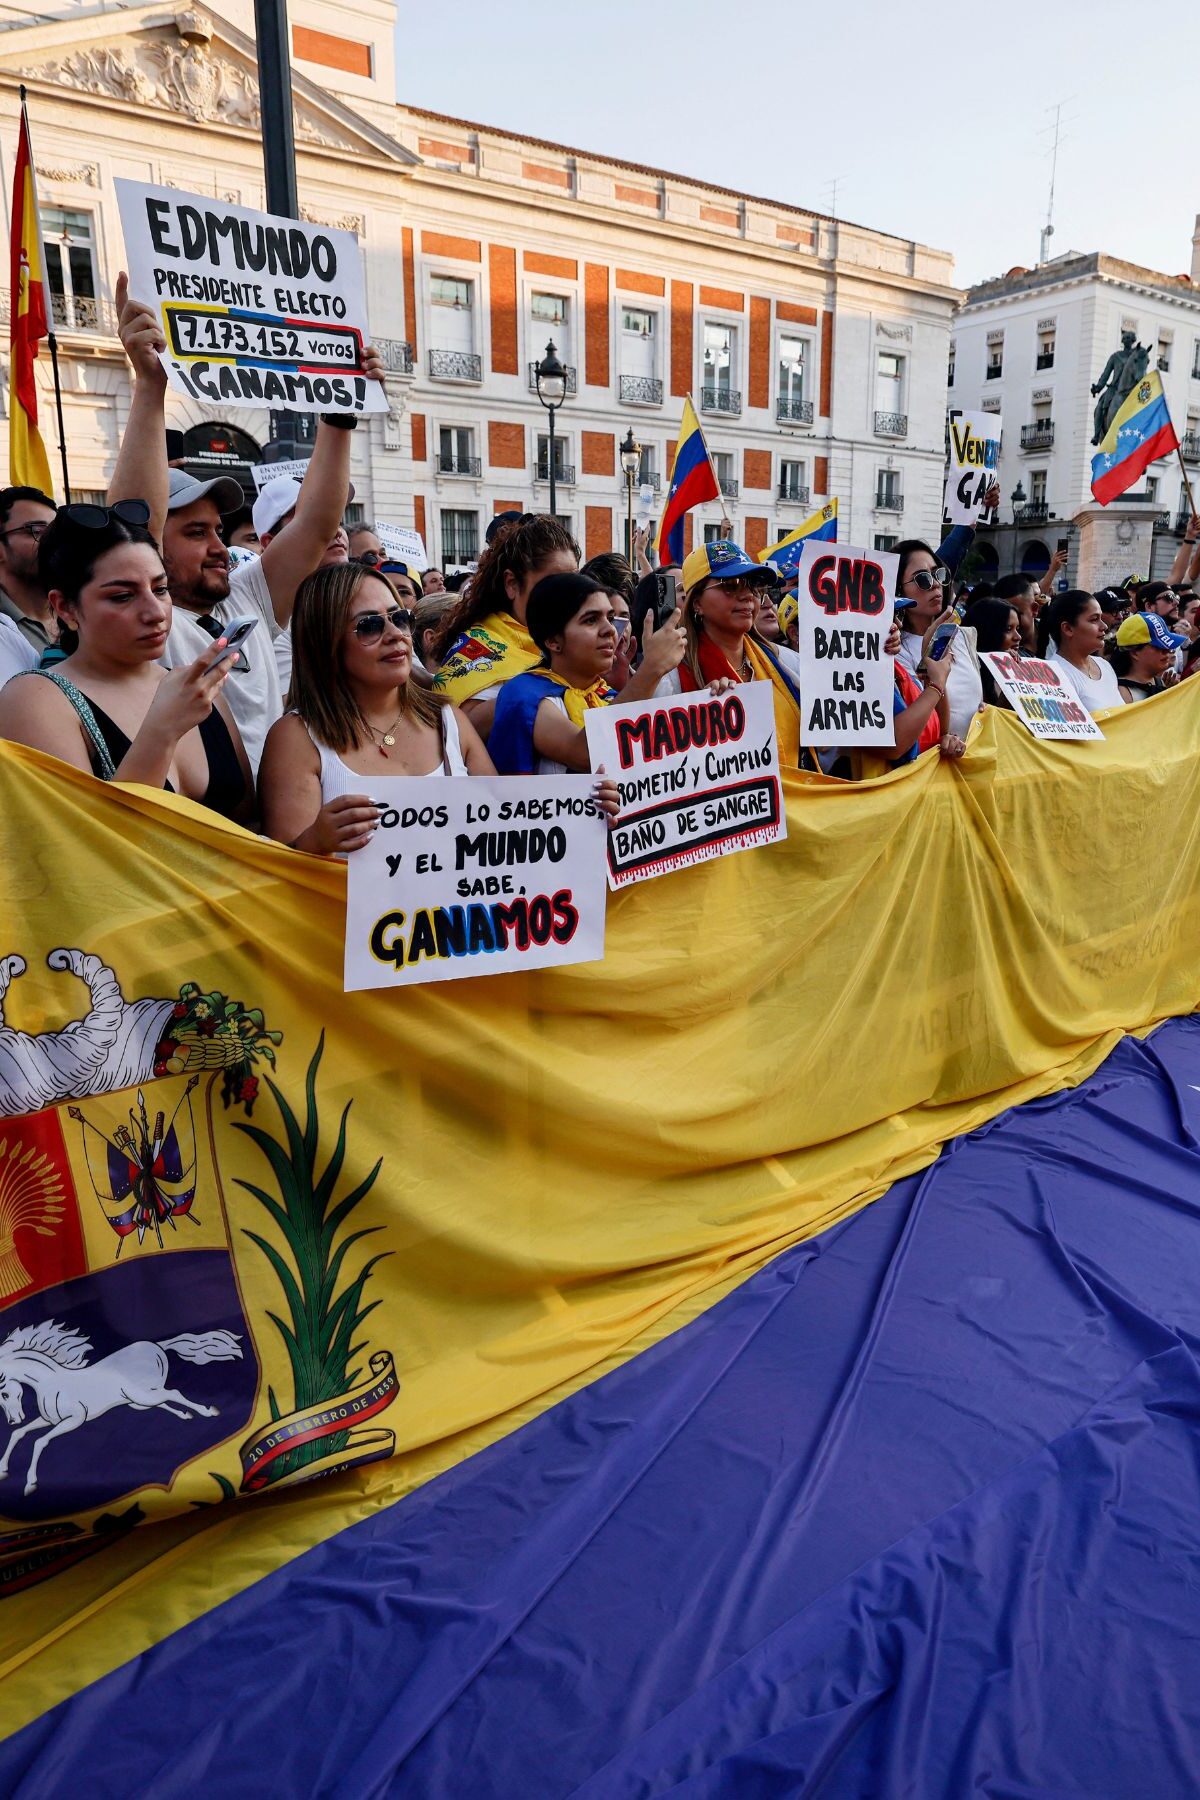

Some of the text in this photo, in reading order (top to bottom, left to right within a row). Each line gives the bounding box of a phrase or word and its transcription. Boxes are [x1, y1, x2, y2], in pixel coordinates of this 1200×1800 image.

[145, 197, 337, 282] EDMUNDO
[153, 268, 346, 319] PRESIDENTE ELECTO
[177, 315, 354, 360] 7.173.152 VOTOS
[1037, 320, 1056, 329] HOSTAL
[171, 361, 367, 410] ¡GANAMOS!
[1033, 389, 1051, 399] HOSTAL
[272, 463, 308, 472] VENEZUE
[808, 555, 885, 616] GNB
[814, 626, 880, 661] BAJEN
[832, 671, 864, 693] LAS
[615, 695, 745, 770] MADURO
[808, 698, 886, 731] ARMAS
[1030, 722, 1096, 734] TENEMOS VOTOS
[616, 754, 688, 807] ROMETIÓ
[466, 803, 490, 823] LO
[498, 798, 605, 821] SABEMOS,
[616, 791, 768, 858] BAÑO DE SANGRE
[415, 853, 443, 874] EL
[455, 826, 567, 871] MUNDO
[369, 888, 579, 972] GANAMOS
[249, 1376, 394, 1463] 20 DE FEBRERO DE 1859
